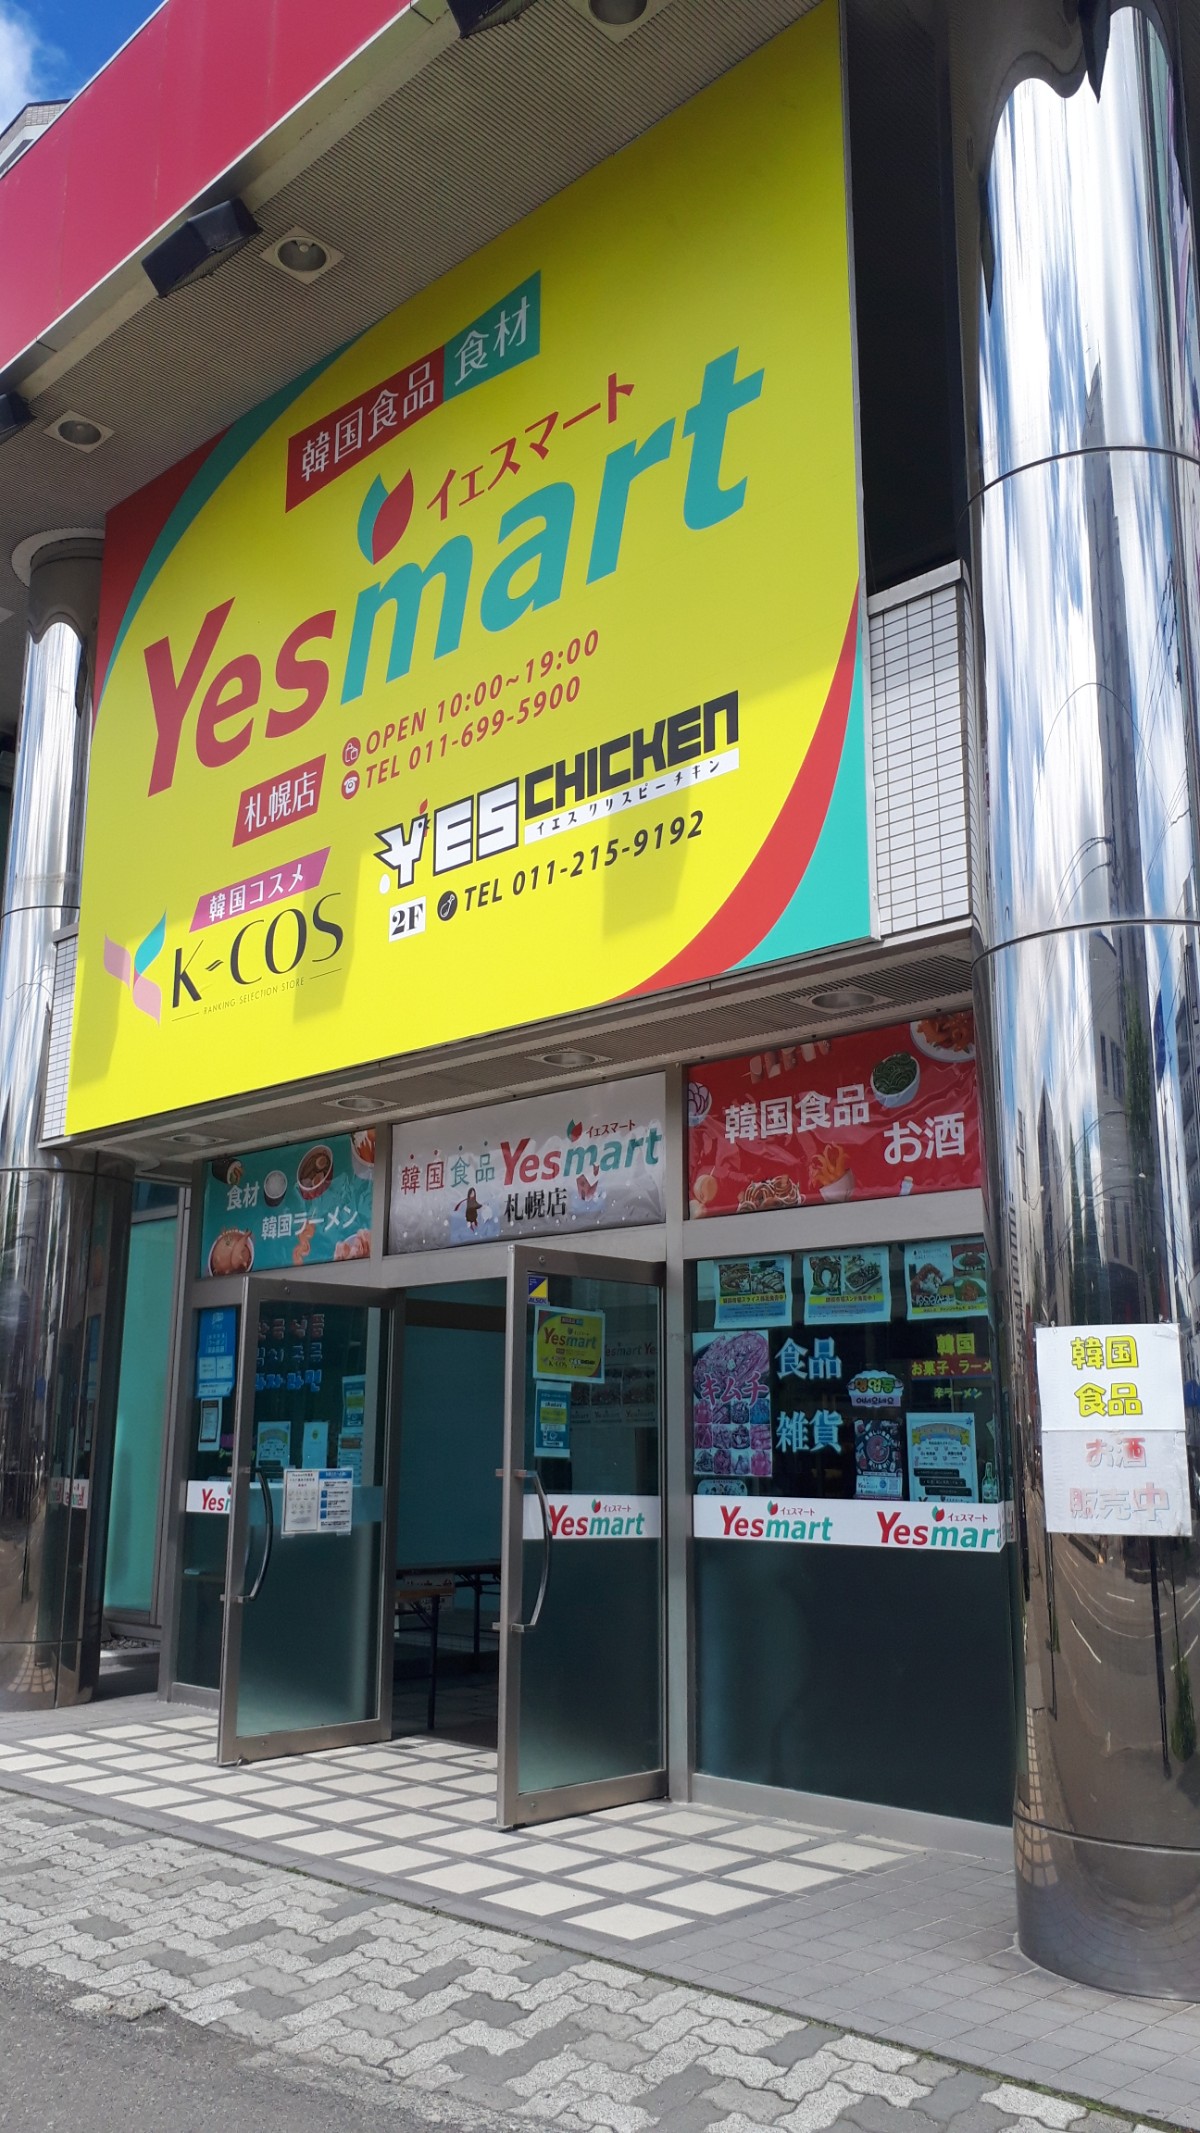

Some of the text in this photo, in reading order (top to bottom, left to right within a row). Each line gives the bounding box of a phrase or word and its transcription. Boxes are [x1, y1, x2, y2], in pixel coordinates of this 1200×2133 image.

[454, 295, 530, 386] 食材
[300, 361, 435, 483] 韓国食品
[143, 346, 765, 797] Yesmart
[366, 676, 580, 789] TEL 011-699-5900
[366, 711, 426, 755] OPEN
[244, 770, 317, 832] 札幌店
[464, 810, 704, 911] TEL 011-215-9192
[209, 864, 304, 922] 韓国コスメ
[392, 903, 423, 937] 2F
[172, 892, 344, 1009] K-COS
[203, 977, 305, 1015] RANKING SELECTION STORE
[724, 1084, 870, 1144] 韓国食品
[501, 1127, 663, 1186] Yesmart
[883, 1112, 965, 1164] お酒
[226, 1181, 260, 1212] 食材
[503, 1188, 568, 1222] 札幌店
[261, 1205, 358, 1241] 韓国ラーメン
[544, 1326, 598, 1349] Yesmart
[775, 1336, 842, 1380] 食品
[1071, 1335, 1139, 1370] 韓国
[700, 1371, 769, 1406] キムチ
[934, 1387, 983, 1399] 辛ラーメン
[1074, 1382, 1143, 1417] 食品
[776, 1409, 843, 1453] 雑貨
[1086, 1437, 1147, 1468] お酒
[549, 1504, 645, 1536] Yesmart
[1069, 1482, 1170, 1521] 販売中
[720, 1505, 833, 1541] Yesmart
